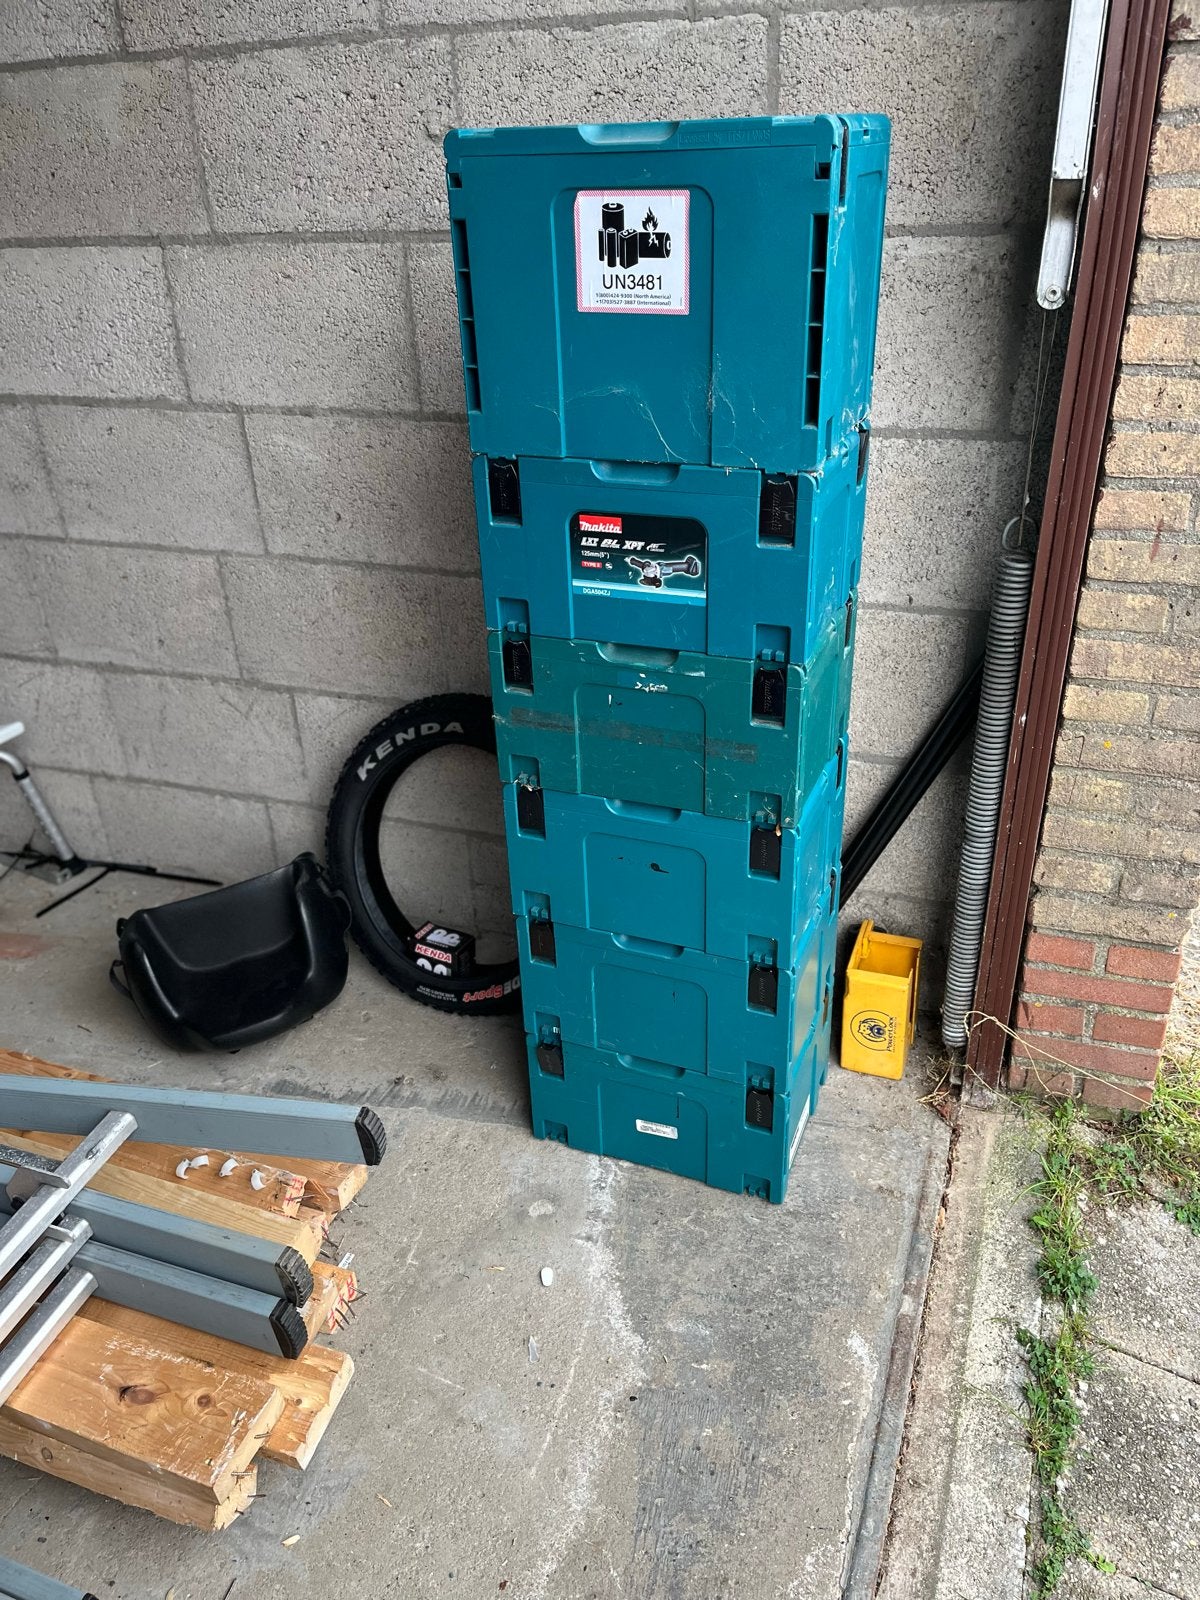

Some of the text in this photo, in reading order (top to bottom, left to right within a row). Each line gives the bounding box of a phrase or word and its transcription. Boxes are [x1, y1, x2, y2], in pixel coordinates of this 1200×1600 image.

[602, 274, 662, 290] UN3481
[622, 540, 645, 551] XPT
[581, 550, 610, 559] 125mm(5")
[582, 587, 610, 596] DGA504ZJ
[357, 722, 464, 781] KENDA
[415, 943, 452, 963] KENDA
[463, 984, 503, 1003] Sport
